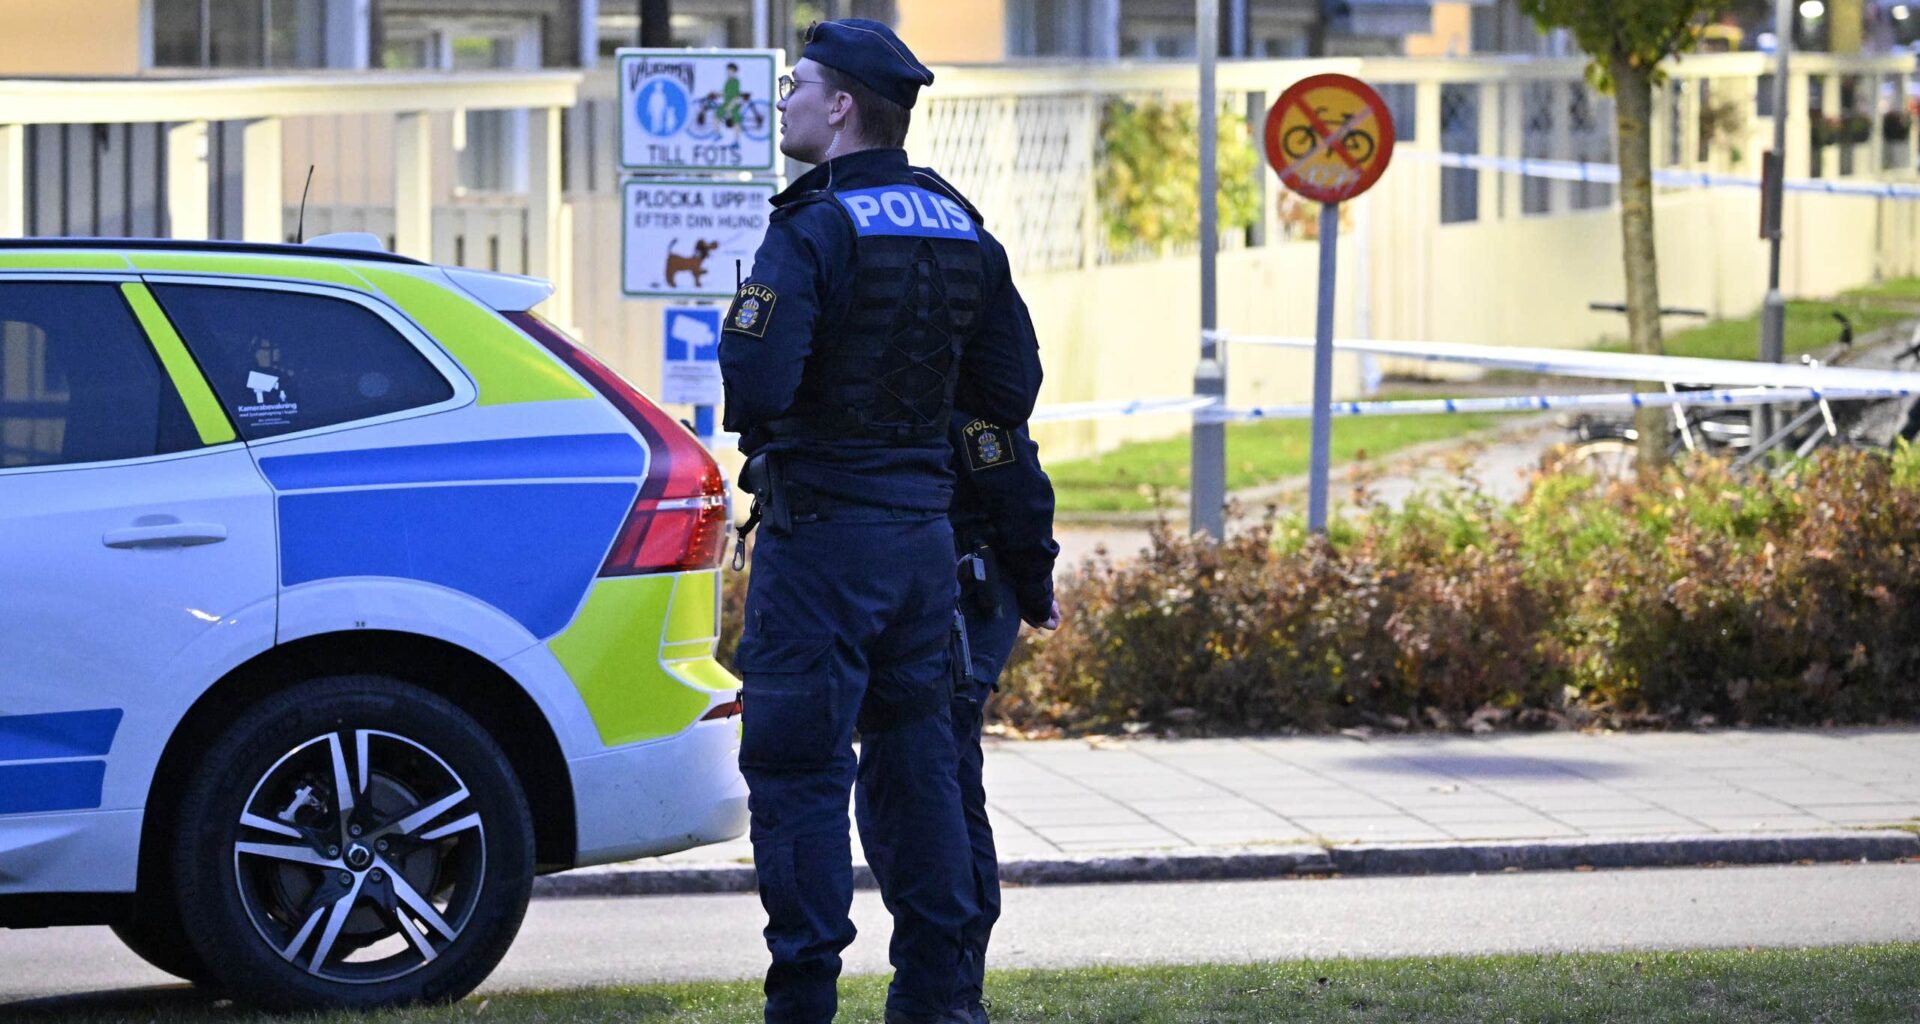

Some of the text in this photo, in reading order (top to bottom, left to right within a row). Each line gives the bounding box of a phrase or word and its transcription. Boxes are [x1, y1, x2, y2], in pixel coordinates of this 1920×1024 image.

[647, 144, 742, 166] TILL FOTS
[634, 190, 704, 208] PLOCKA
[844, 191, 971, 232] POLIS
[634, 212, 764, 229] EFTER DIN HUND
[740, 286, 773, 302] POLIS
[966, 420, 1000, 437] POL
